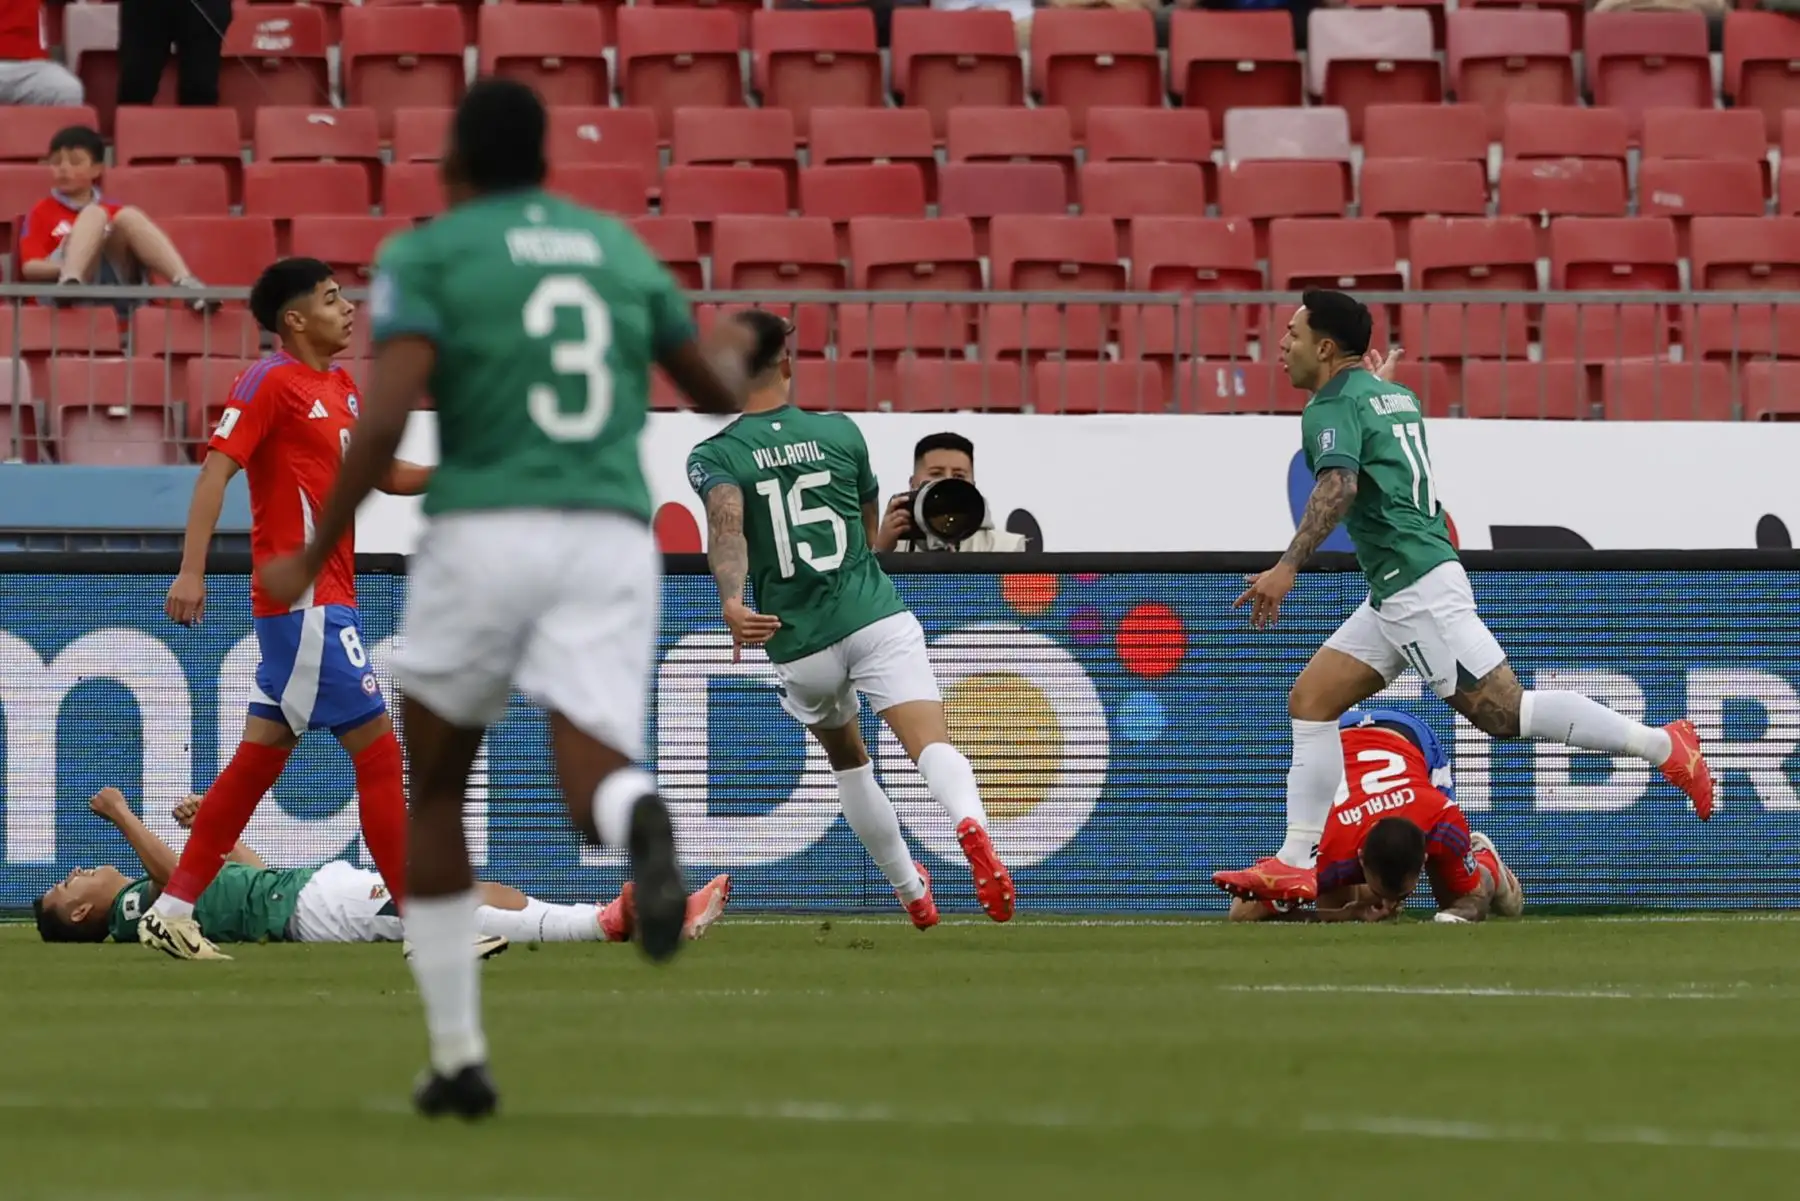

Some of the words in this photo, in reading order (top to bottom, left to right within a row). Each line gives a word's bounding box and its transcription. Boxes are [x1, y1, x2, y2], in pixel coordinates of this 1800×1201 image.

[522, 274, 613, 442] 3
[752, 440, 825, 470] VILLAMIL
[1392, 422, 1437, 518] 11
[755, 470, 848, 579] 15
[339, 625, 366, 668] 8
[1401, 641, 1433, 678] 11
[1337, 787, 1415, 826] CATALÁN
